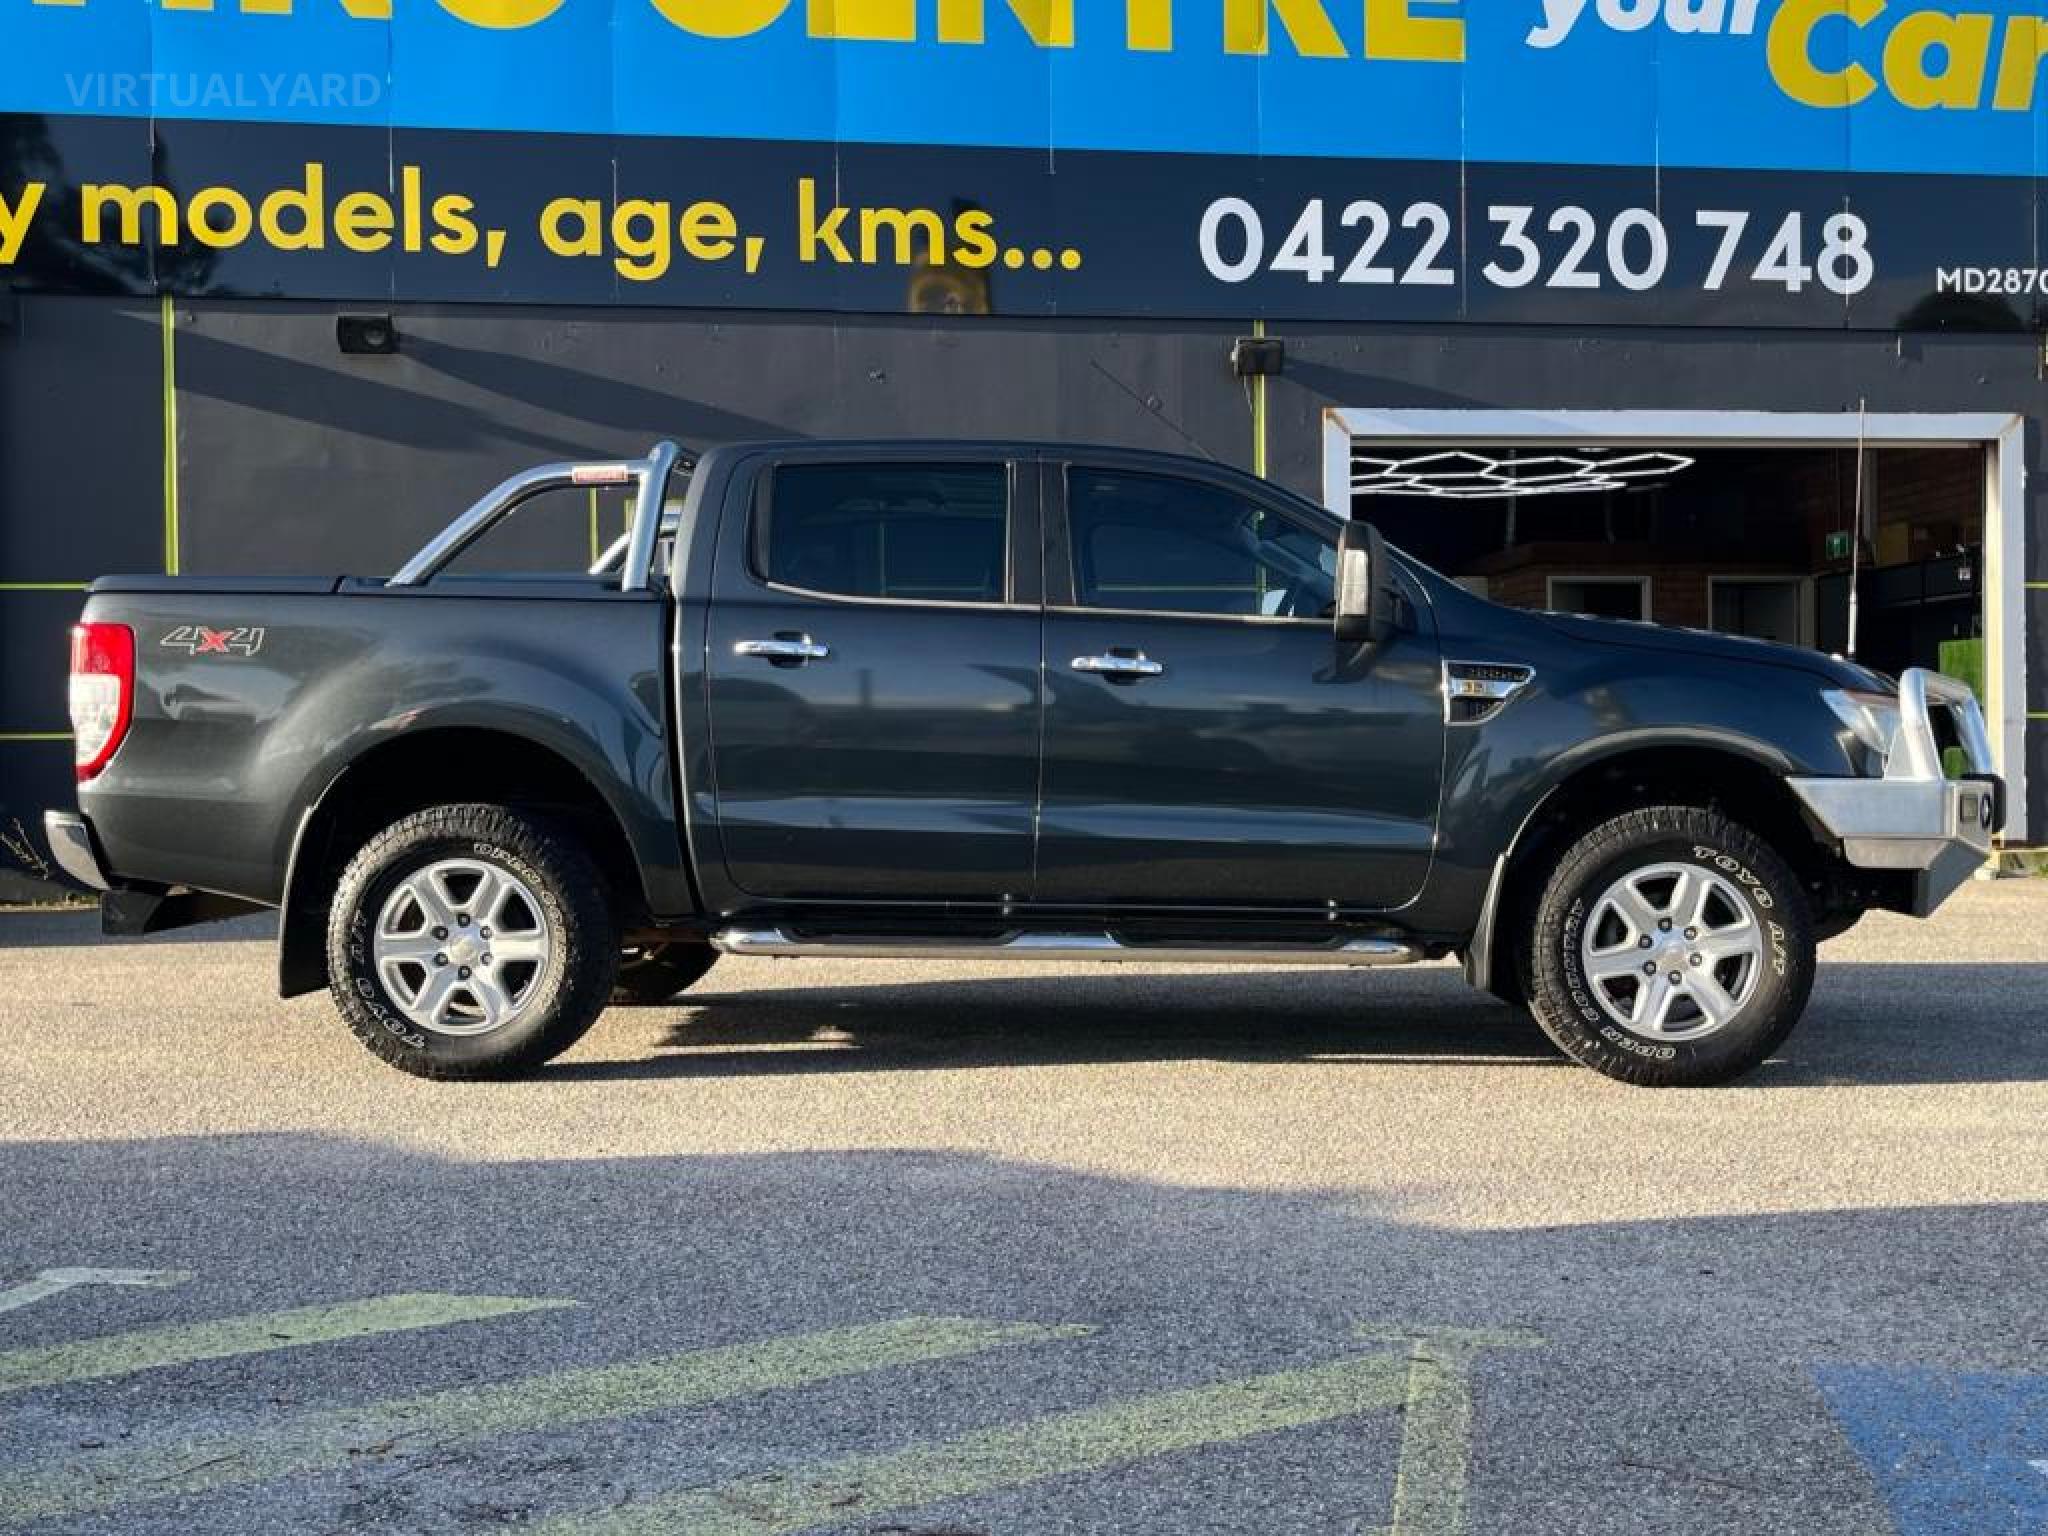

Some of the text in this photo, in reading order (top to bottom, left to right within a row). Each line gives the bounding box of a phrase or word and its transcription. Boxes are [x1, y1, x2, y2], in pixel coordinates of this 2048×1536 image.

[81, 163, 506, 268] models,
[538, 197, 764, 281] age,
[799, 178, 1081, 270] kms...
[1199, 197, 1874, 294] 0422 320 748
[1693, 845, 1774, 910] TOYO
